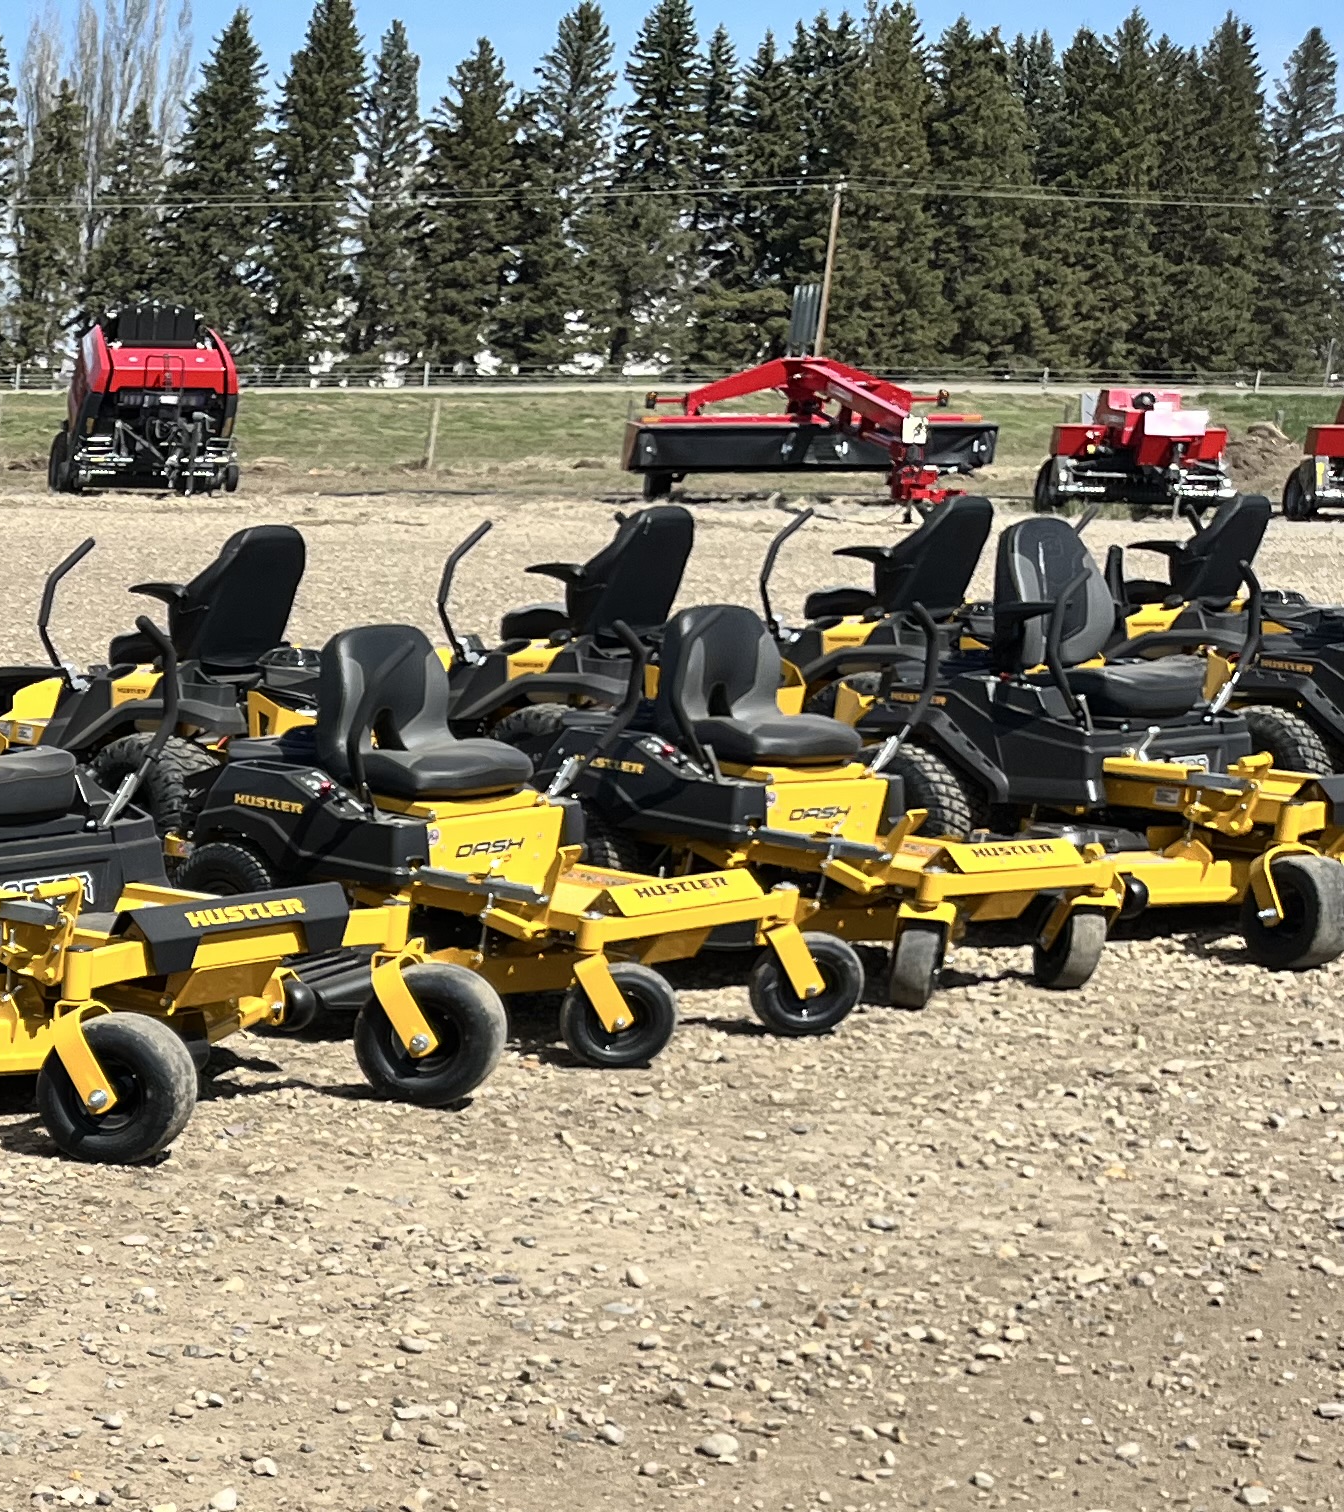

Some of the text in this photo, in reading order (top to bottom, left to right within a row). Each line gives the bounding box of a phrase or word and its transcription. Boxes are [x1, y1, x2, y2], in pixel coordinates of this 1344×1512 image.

[234, 793, 305, 814] HUSTLER
[789, 806, 851, 821] DASH
[456, 838, 525, 858] DASH
[972, 844, 1053, 858] HUSTLER
[634, 877, 728, 898] HUSTLER
[184, 898, 306, 928] HUSTLER
